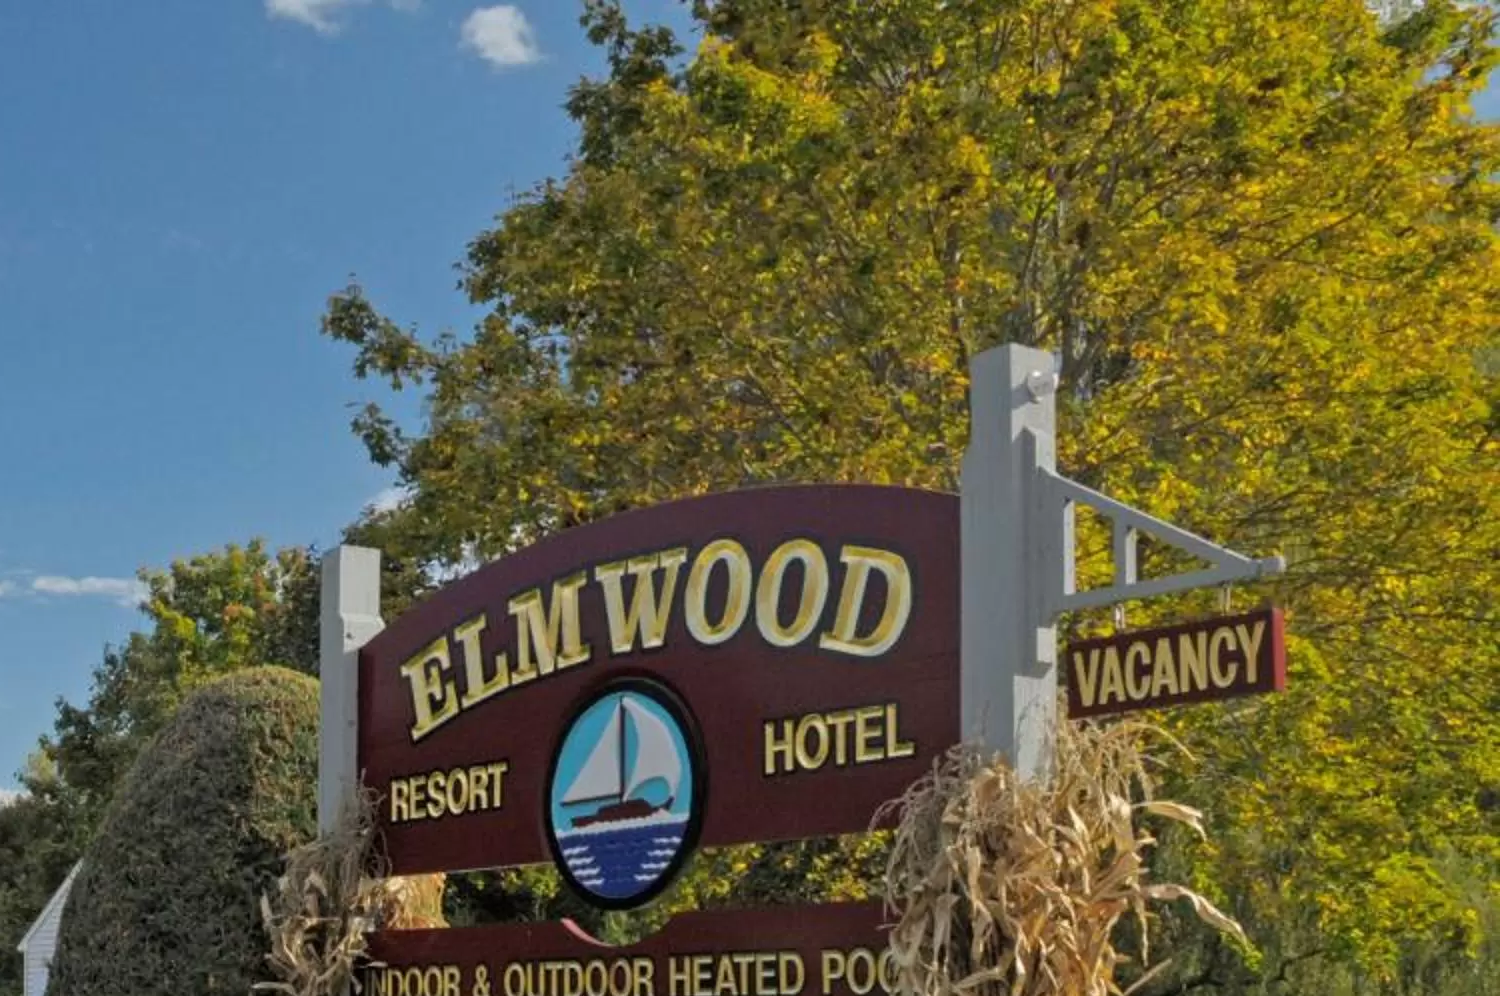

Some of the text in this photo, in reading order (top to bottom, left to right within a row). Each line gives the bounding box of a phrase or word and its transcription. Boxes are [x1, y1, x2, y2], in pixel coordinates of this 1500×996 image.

[401, 538, 912, 741] ELMWOOD
[1073, 620, 1266, 707] VACANCY
[390, 703, 915, 822] RESORT HOTEL
[821, 950, 902, 996] POO
